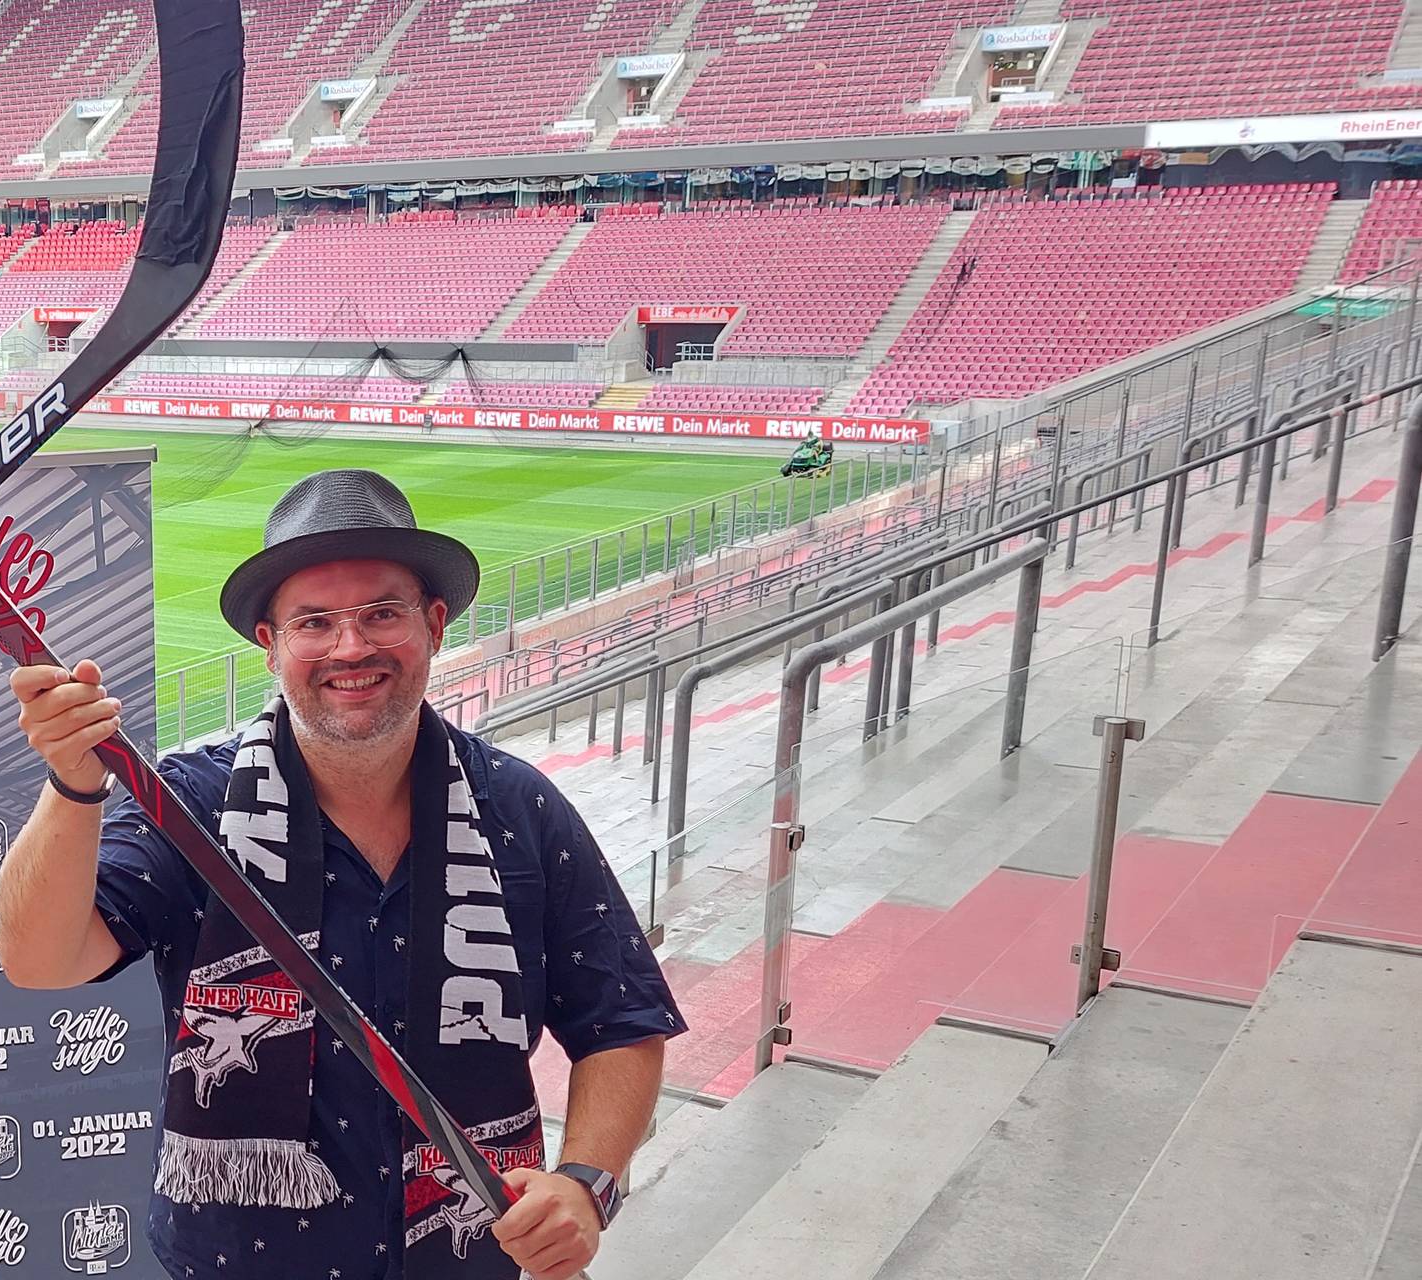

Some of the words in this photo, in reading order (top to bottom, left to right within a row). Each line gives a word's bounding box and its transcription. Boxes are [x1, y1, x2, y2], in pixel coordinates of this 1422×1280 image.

[124, 401, 160, 415] REWE
[165, 402, 186, 415] Dein
[189, 403, 221, 417] Markt
[231, 404, 270, 418] REWE
[277, 405, 300, 418] Dein
[303, 406, 336, 420] Markt
[350, 407, 393, 422] REWE
[400, 409, 424, 423] Dein
[475, 410, 521, 427] REWE
[529, 412, 556, 428] Dein
[560, 414, 600, 430] Markt
[613, 415, 664, 432] REWE
[673, 417, 707, 433] Dein
[712, 419, 751, 435] Markt
[766, 420, 823, 438] REWE
[832, 423, 866, 439] Dein
[869, 425, 919, 442] Markt
[245, 986, 298, 1017] HAIE
[32, 1120, 63, 1138] 01.
[69, 1111, 153, 1135] JANUAR
[61, 1132, 126, 1160] 2022
